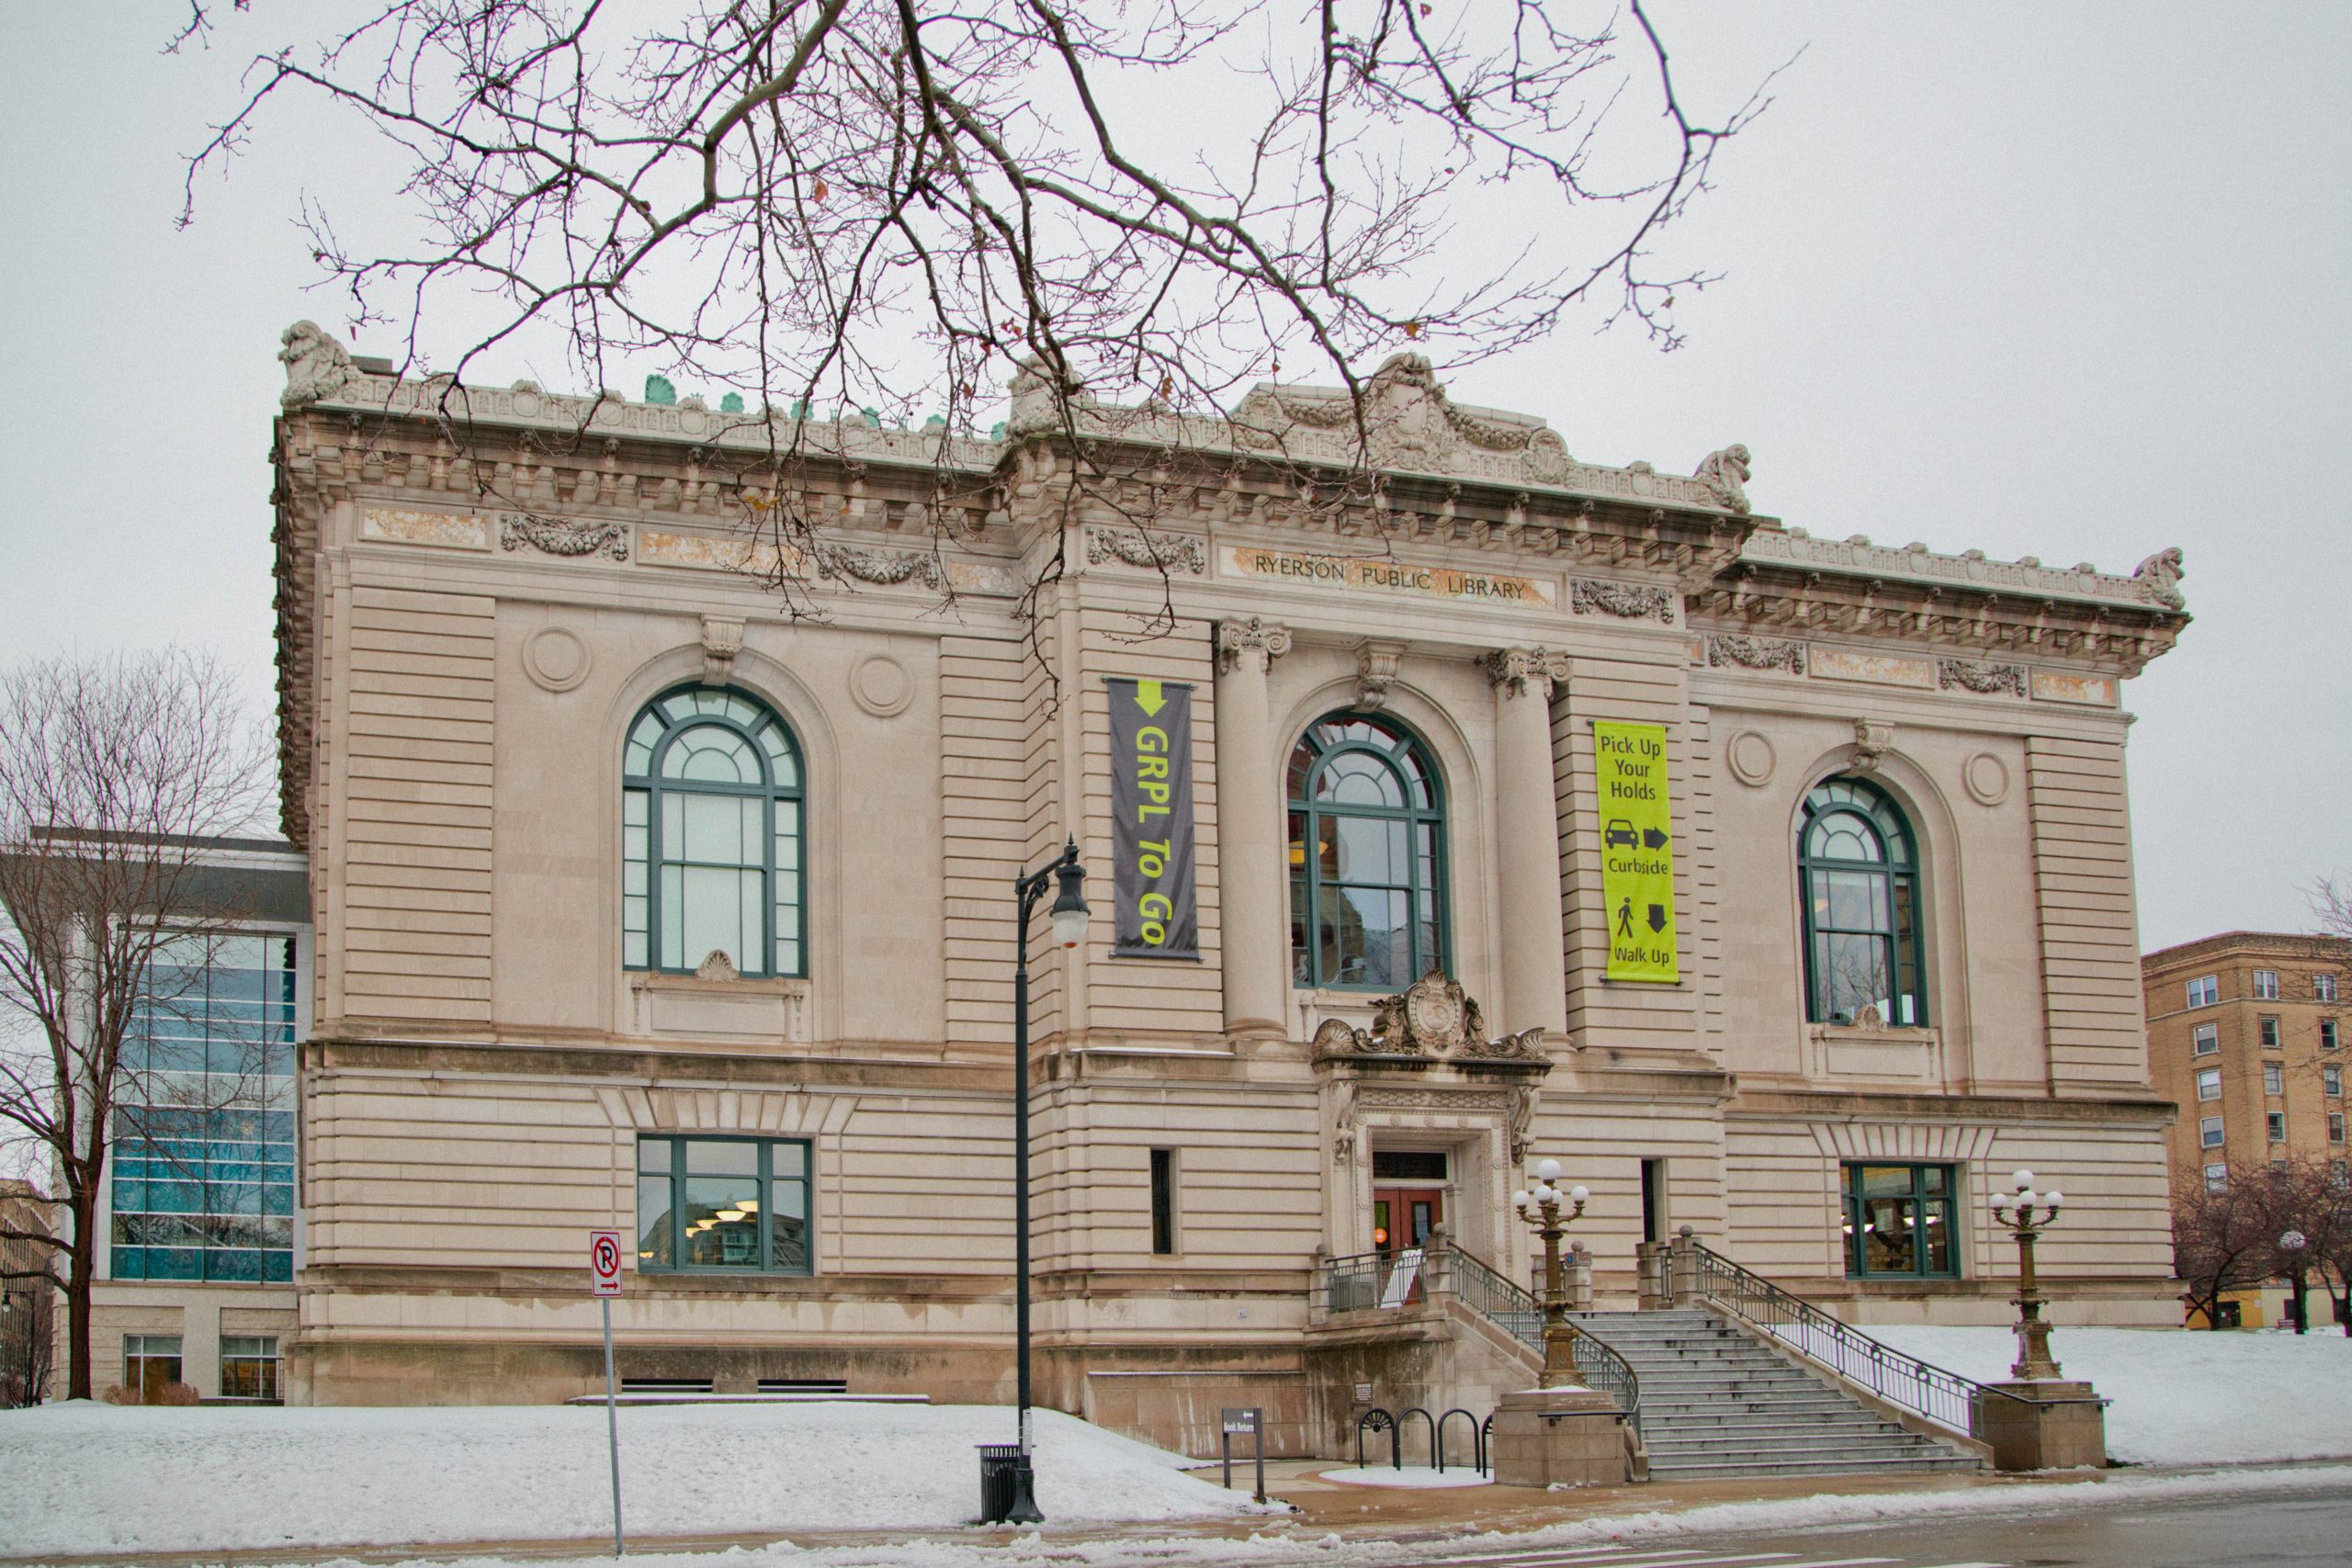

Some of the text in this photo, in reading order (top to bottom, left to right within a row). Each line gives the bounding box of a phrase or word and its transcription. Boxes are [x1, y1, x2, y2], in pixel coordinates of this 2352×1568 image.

[1256, 555, 1525, 599] RYERSON PUBLIC LIBRARY
[1601, 735, 1660, 761] Pick Up
[1136, 726, 1170, 824] GRPL
[1614, 758, 1650, 778] Your
[1611, 781, 1656, 800] Holds
[1608, 858, 1668, 875] Curbside
[1614, 946, 1669, 967] Walk Up
[1223, 1421, 1255, 1432] Book Return
